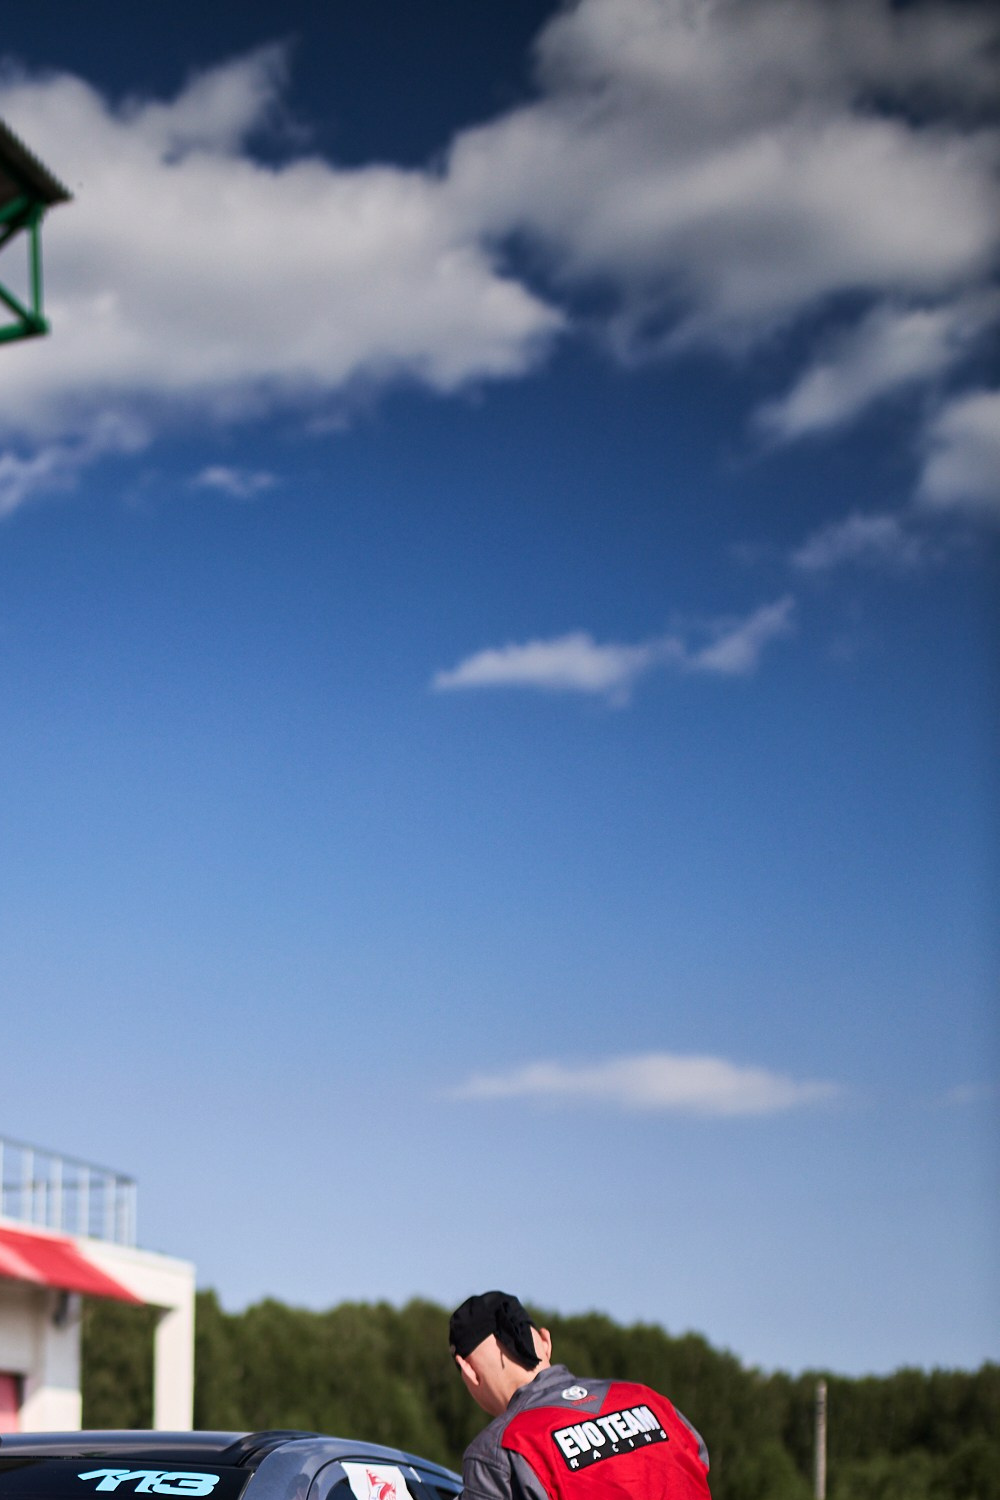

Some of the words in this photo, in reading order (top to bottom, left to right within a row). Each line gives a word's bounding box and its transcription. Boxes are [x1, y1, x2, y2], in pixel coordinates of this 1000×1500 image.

[555, 1421, 605, 1459] EVO
[598, 1405, 661, 1441] TEAM
[569, 1429, 667, 1469] RACING
[78, 1468, 220, 1497] 113
